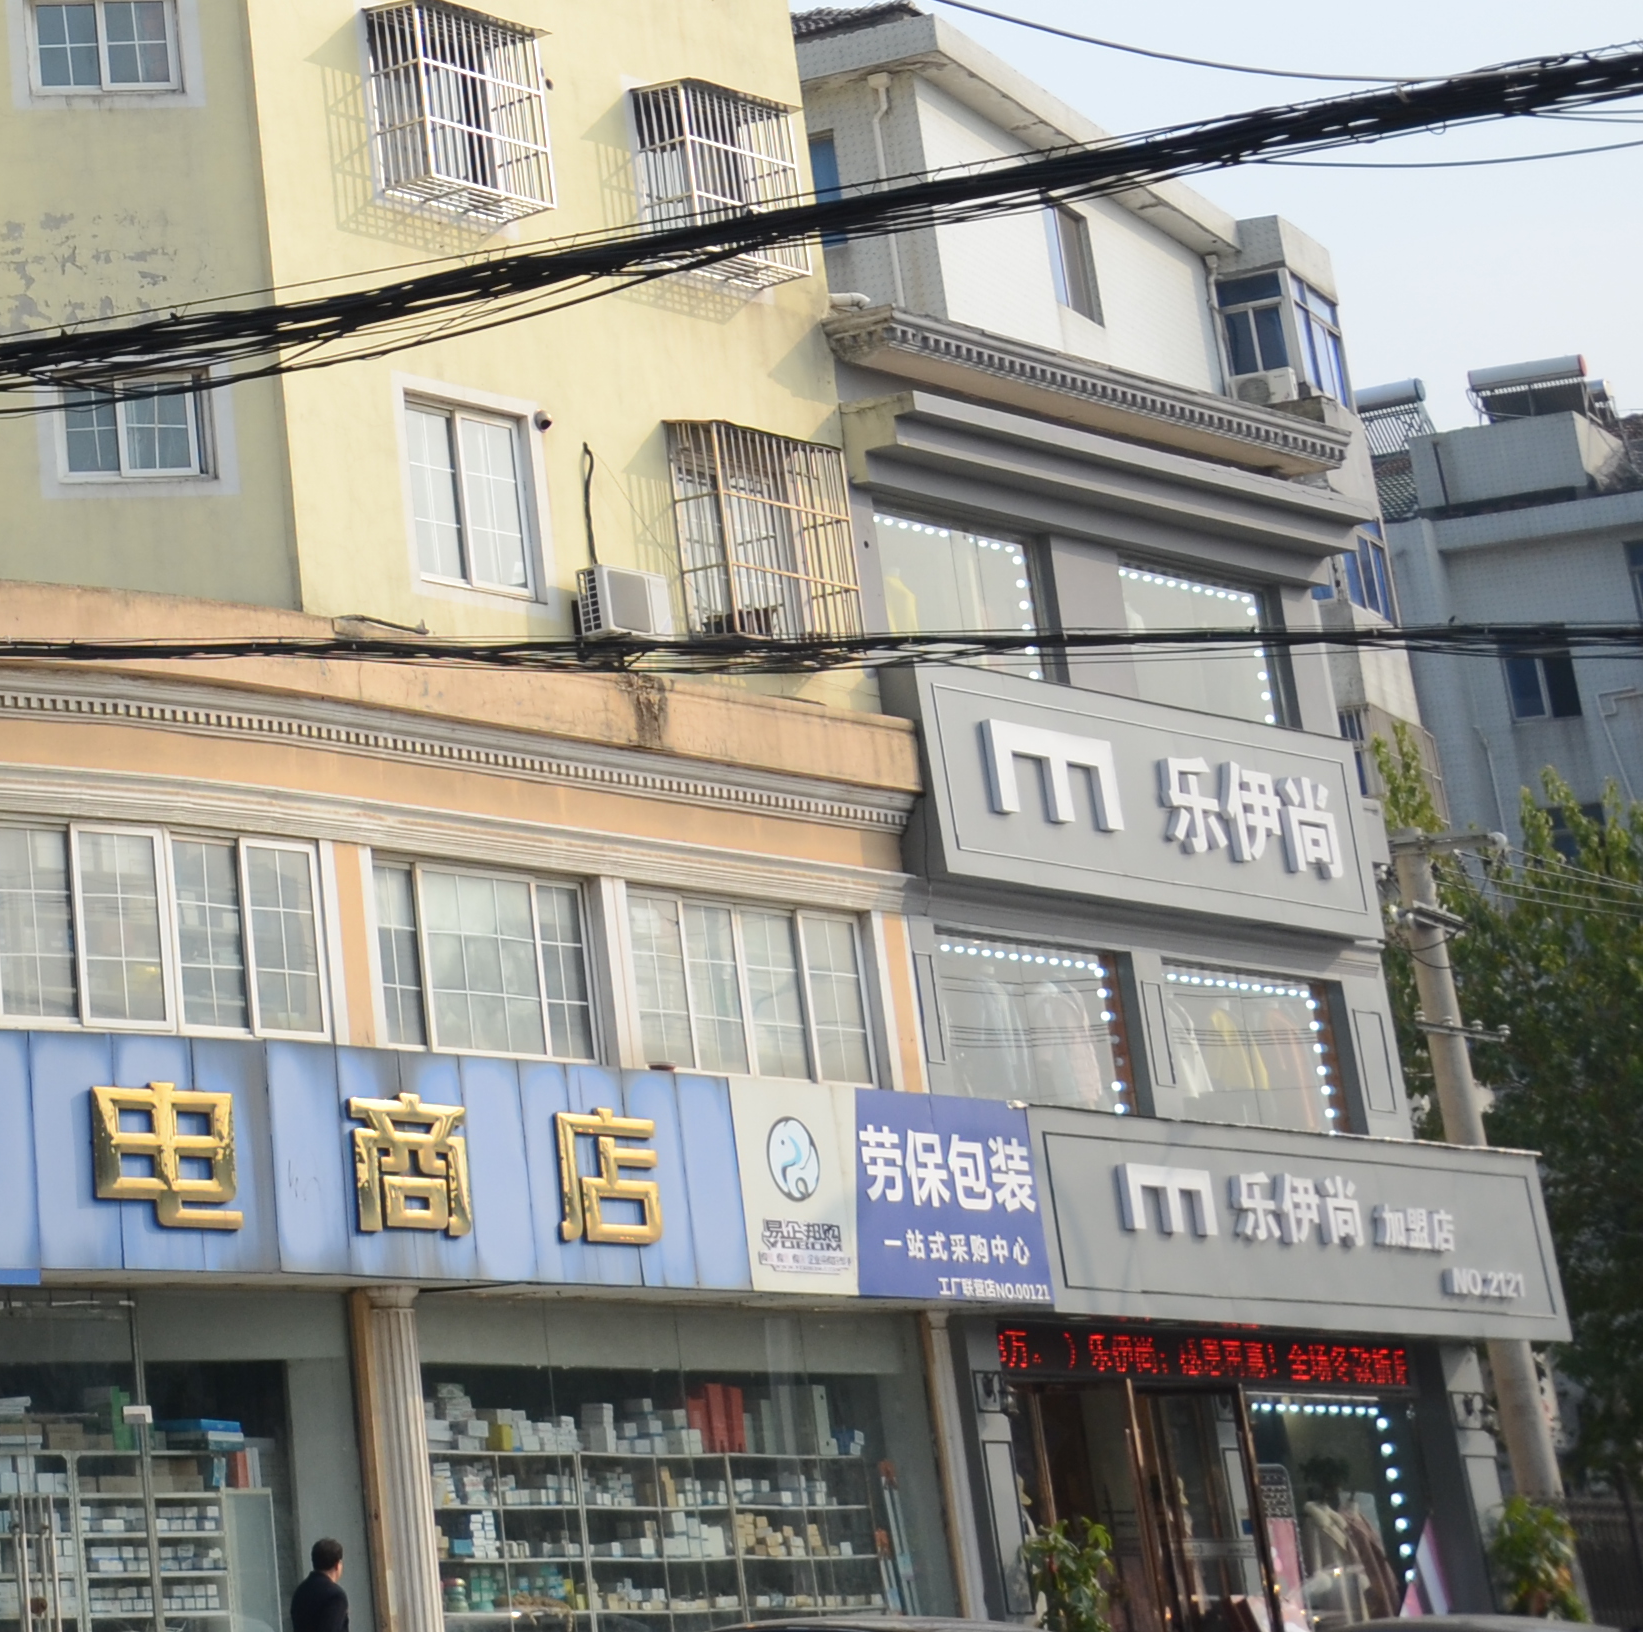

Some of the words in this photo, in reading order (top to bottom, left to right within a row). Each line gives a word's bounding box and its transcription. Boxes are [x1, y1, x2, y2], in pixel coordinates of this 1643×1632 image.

[1158, 756, 1344, 879] 乐伊尚
[858, 1124, 1037, 1214] 劳保包装
[1230, 1171, 1365, 1249] 乐伊尚
[1375, 1204, 1457, 1253] 加盟店
[883, 1228, 1032, 1266] 一站式采购中心
[937, 1277, 1052, 1301] 工厂联营店NO.00121
[1443, 1266, 1527, 1299] NO.2121
